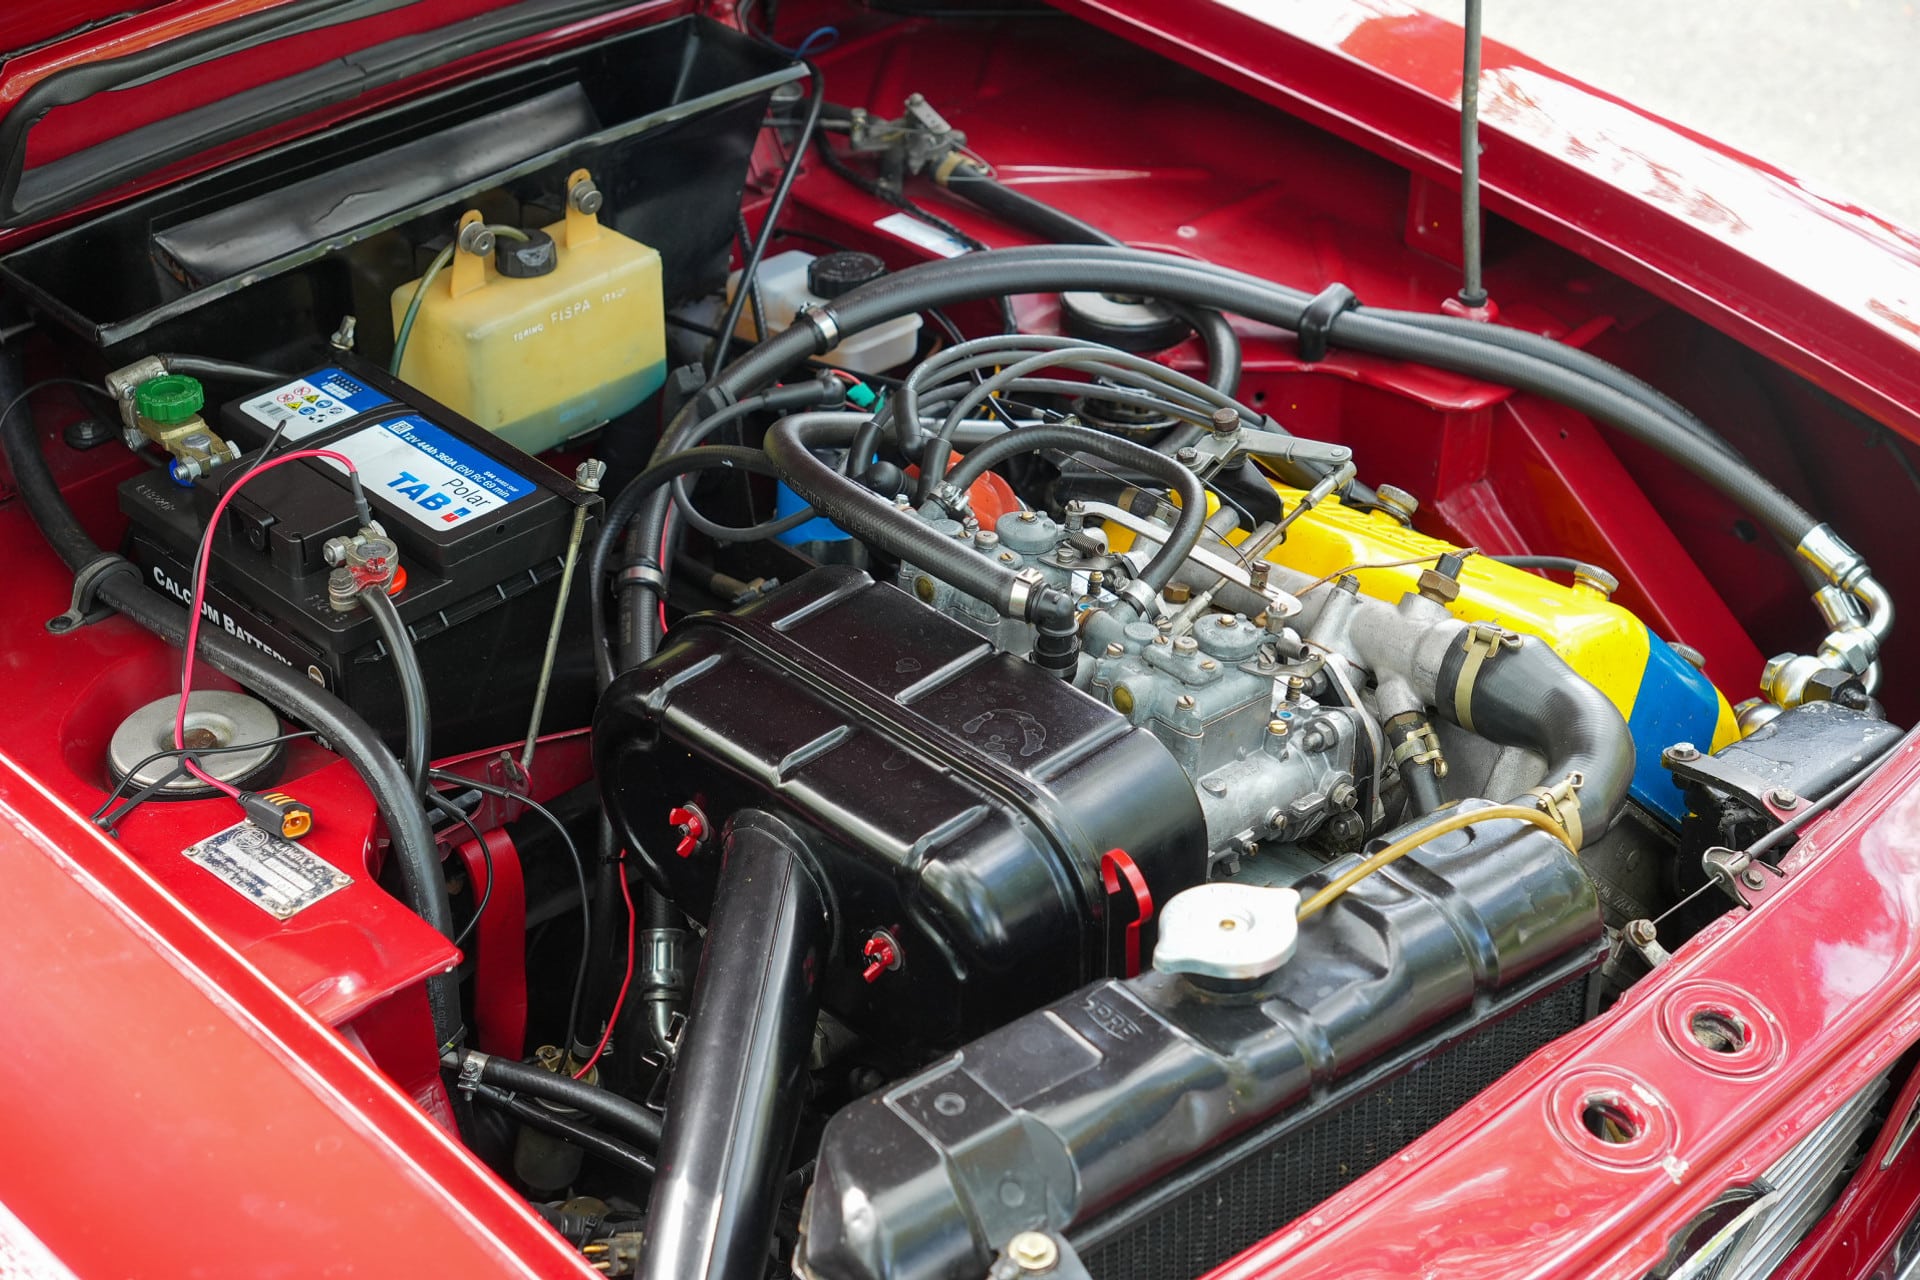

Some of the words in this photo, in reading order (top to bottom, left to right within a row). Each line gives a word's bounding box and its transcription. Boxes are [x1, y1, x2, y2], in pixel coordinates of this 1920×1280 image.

[512, 322, 544, 342] TORINO
[550, 299, 591, 324] FISPA
[402, 432, 420, 444] 12V
[417, 441, 438, 455] 44Ah
[435, 452, 458, 467] 360A
[454, 464, 475, 477] (EN)
[471, 473, 486, 483] RC
[483, 481, 497, 489] 69
[493, 487, 510, 498] min
[387, 471, 452, 511] TAB
[441, 478, 491, 507] Polar
[153, 566, 220, 626] CALCUM
[223, 613, 293, 667] BATTE
